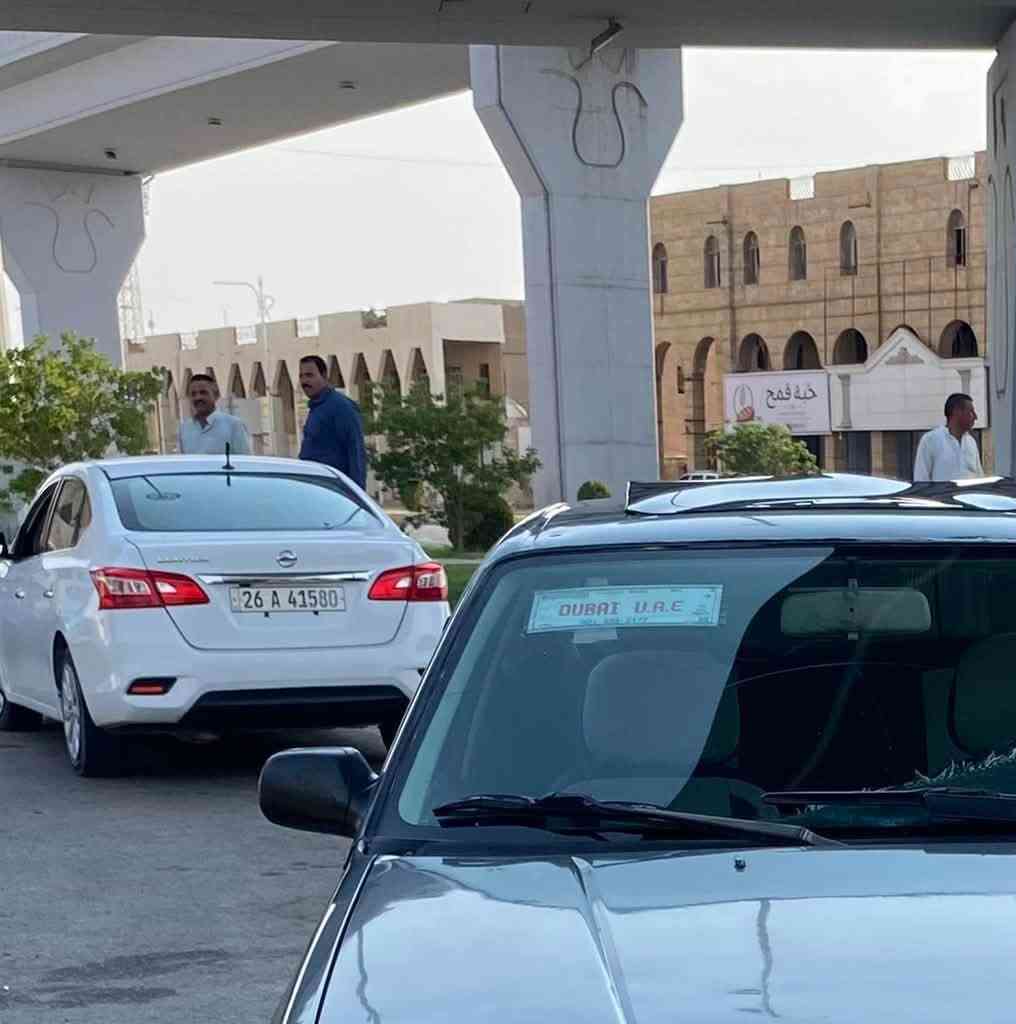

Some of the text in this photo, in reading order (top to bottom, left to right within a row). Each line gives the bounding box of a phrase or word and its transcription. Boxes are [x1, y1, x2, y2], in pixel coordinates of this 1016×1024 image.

[243, 588, 338, 609] 26 A 41580
[558, 601, 620, 617] DUBAI
